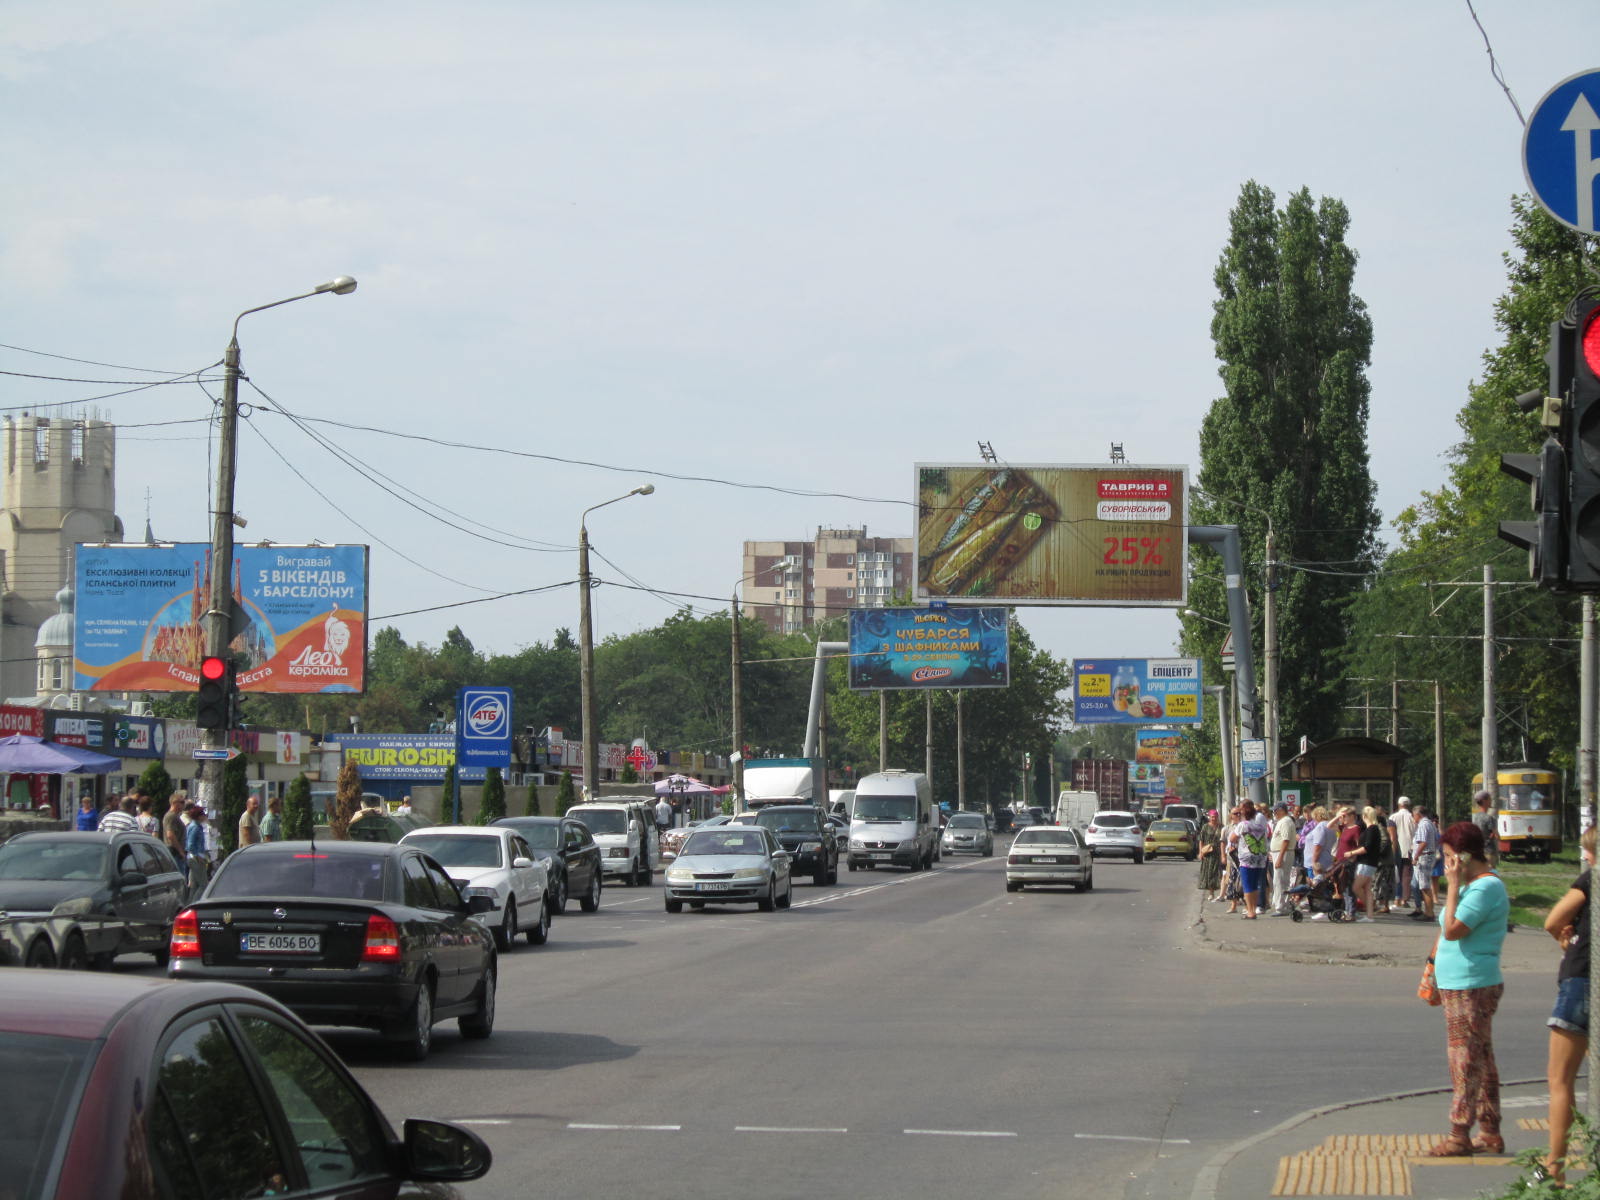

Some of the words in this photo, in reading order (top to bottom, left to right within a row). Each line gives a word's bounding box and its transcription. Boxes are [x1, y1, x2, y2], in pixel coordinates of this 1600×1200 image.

[1101, 503, 1166, 513] СУВОРІВСЬКИЙ
[277, 555, 331, 569] Вигравай
[86, 569, 148, 577] ЕКСКЛЮЗИВНІ
[150, 568, 190, 578] КОЛЕКЦІЇ
[259, 570, 268, 583] 5
[272, 570, 346, 586] ВІКЕНДІВ
[86, 579, 138, 588] ІСПАНСЬКОЇ
[140, 580, 176, 588] ПЛИТКИ
[263, 585, 354, 598] БАРСЕЛОНУ!
[896, 628, 970, 640] ЧУБАРСЯ
[894, 642, 980, 652] ШАФНИКАМИ
[289, 644, 333, 666] Лео
[168, 663, 200, 684] Іспан
[288, 664, 348, 677] кераміка
[1152, 667, 1193, 678] ЕПІЦЕНТР
[471, 710, 497, 721] АТБ
[250, 936, 266, 949] BE
[269, 936, 296, 949] 6056
[299, 936, 317, 949] BO
